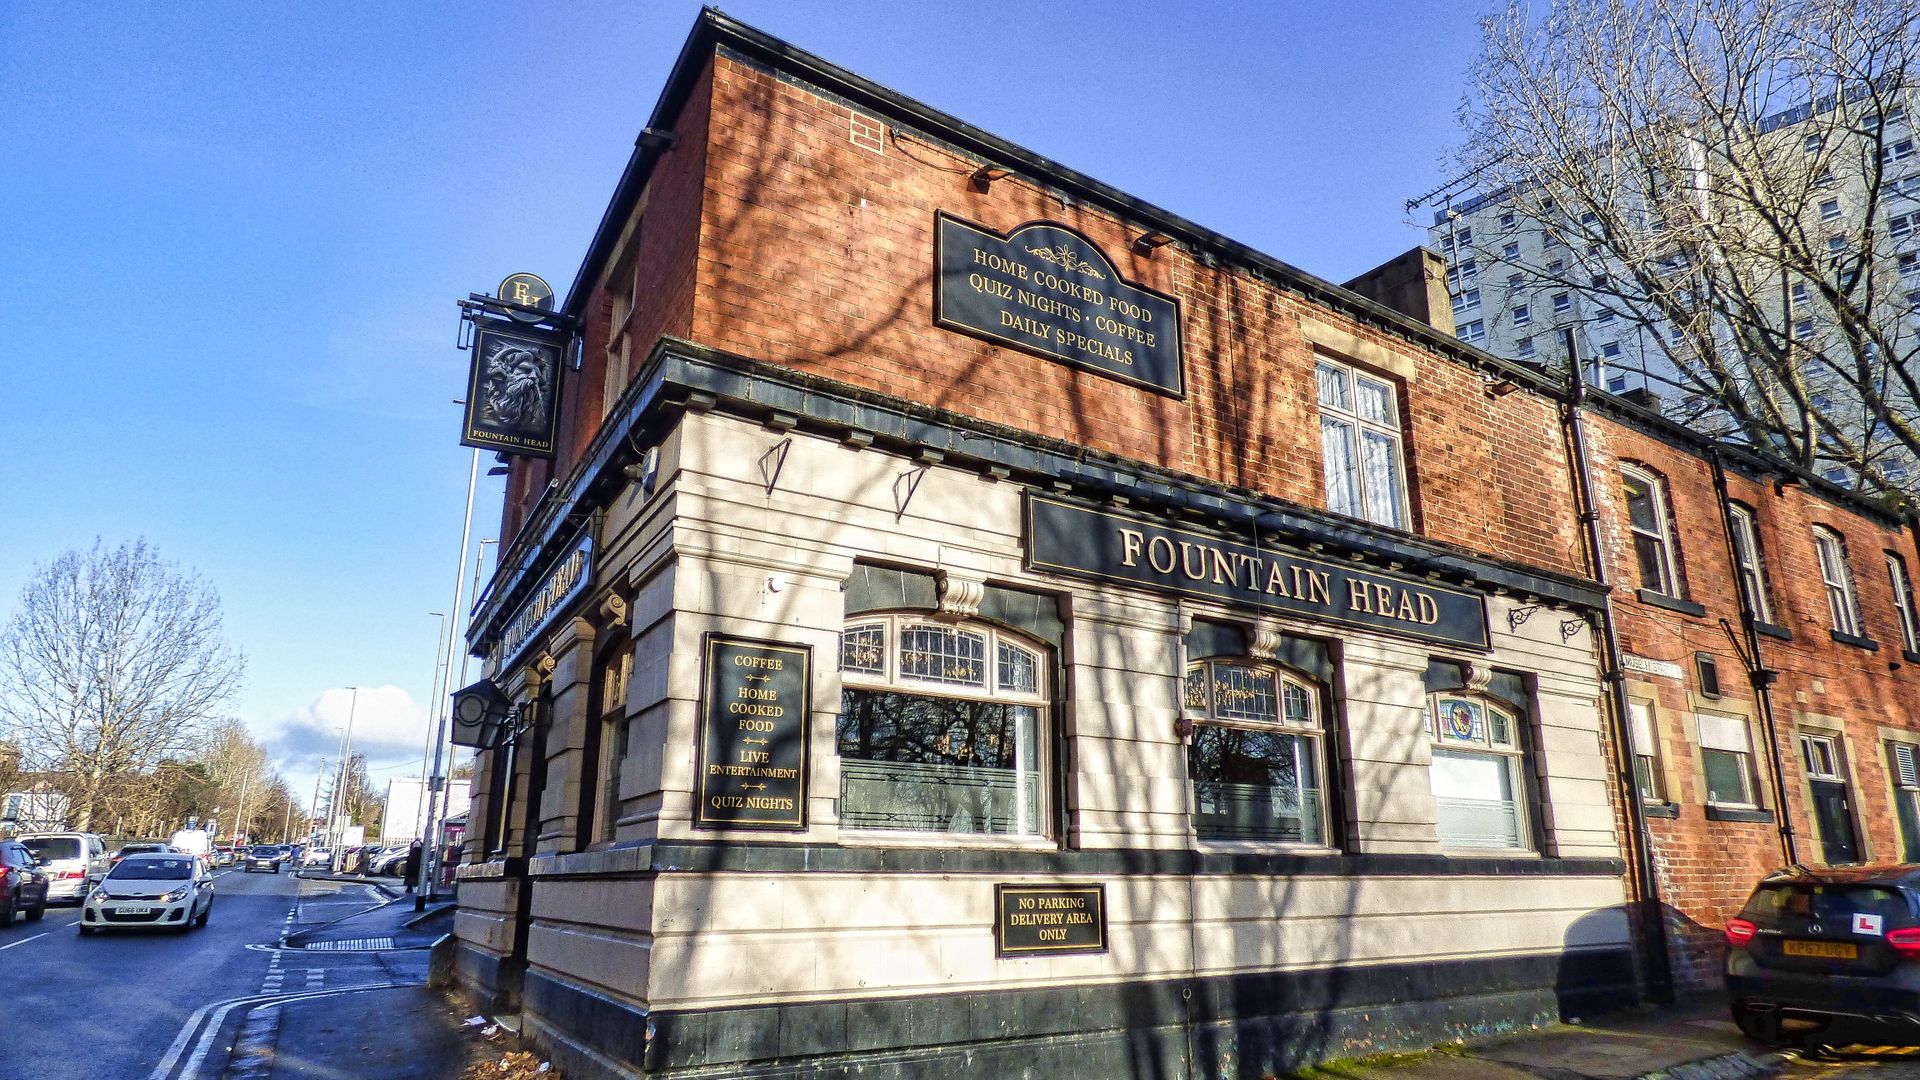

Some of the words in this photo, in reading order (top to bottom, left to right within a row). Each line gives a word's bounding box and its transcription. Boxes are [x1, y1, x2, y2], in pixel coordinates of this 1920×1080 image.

[974, 248, 1028, 280] HOME
[1034, 271, 1104, 305] COOKED
[1109, 297, 1152, 323] FOOD
[969, 273, 1013, 300] QUIZ
[1018, 289, 1081, 323] NIGHTS
[1096, 316, 1155, 347] COFFEE
[1001, 310, 1051, 338] DAILY
[1057, 330, 1133, 366] SPECIALS
[473, 430, 520, 443] FOUNTAIN
[524, 438, 549, 448] HEAD
[1119, 528, 1331, 606] FOUNTAIN
[1346, 577, 1439, 625] HEAD
[734, 655, 783, 671] COFFEE
[738, 687, 777, 701] HOME
[729, 703, 784, 717] COOKED
[739, 720, 774, 732] FOOD
[739, 750, 769, 763] LIVE
[710, 765, 797, 779] ENTERTAINMENT
[711, 796, 743, 809] QUIZ
[746, 796, 793, 810] NIGHTS
[1019, 898, 1035, 909] NO
[1038, 897, 1085, 909] PARKING
[1010, 913, 1064, 926] DELIVERY
[1066, 913, 1093, 924] AREA
[1859, 918, 1874, 930] L
[1039, 929, 1067, 941] ONLY
